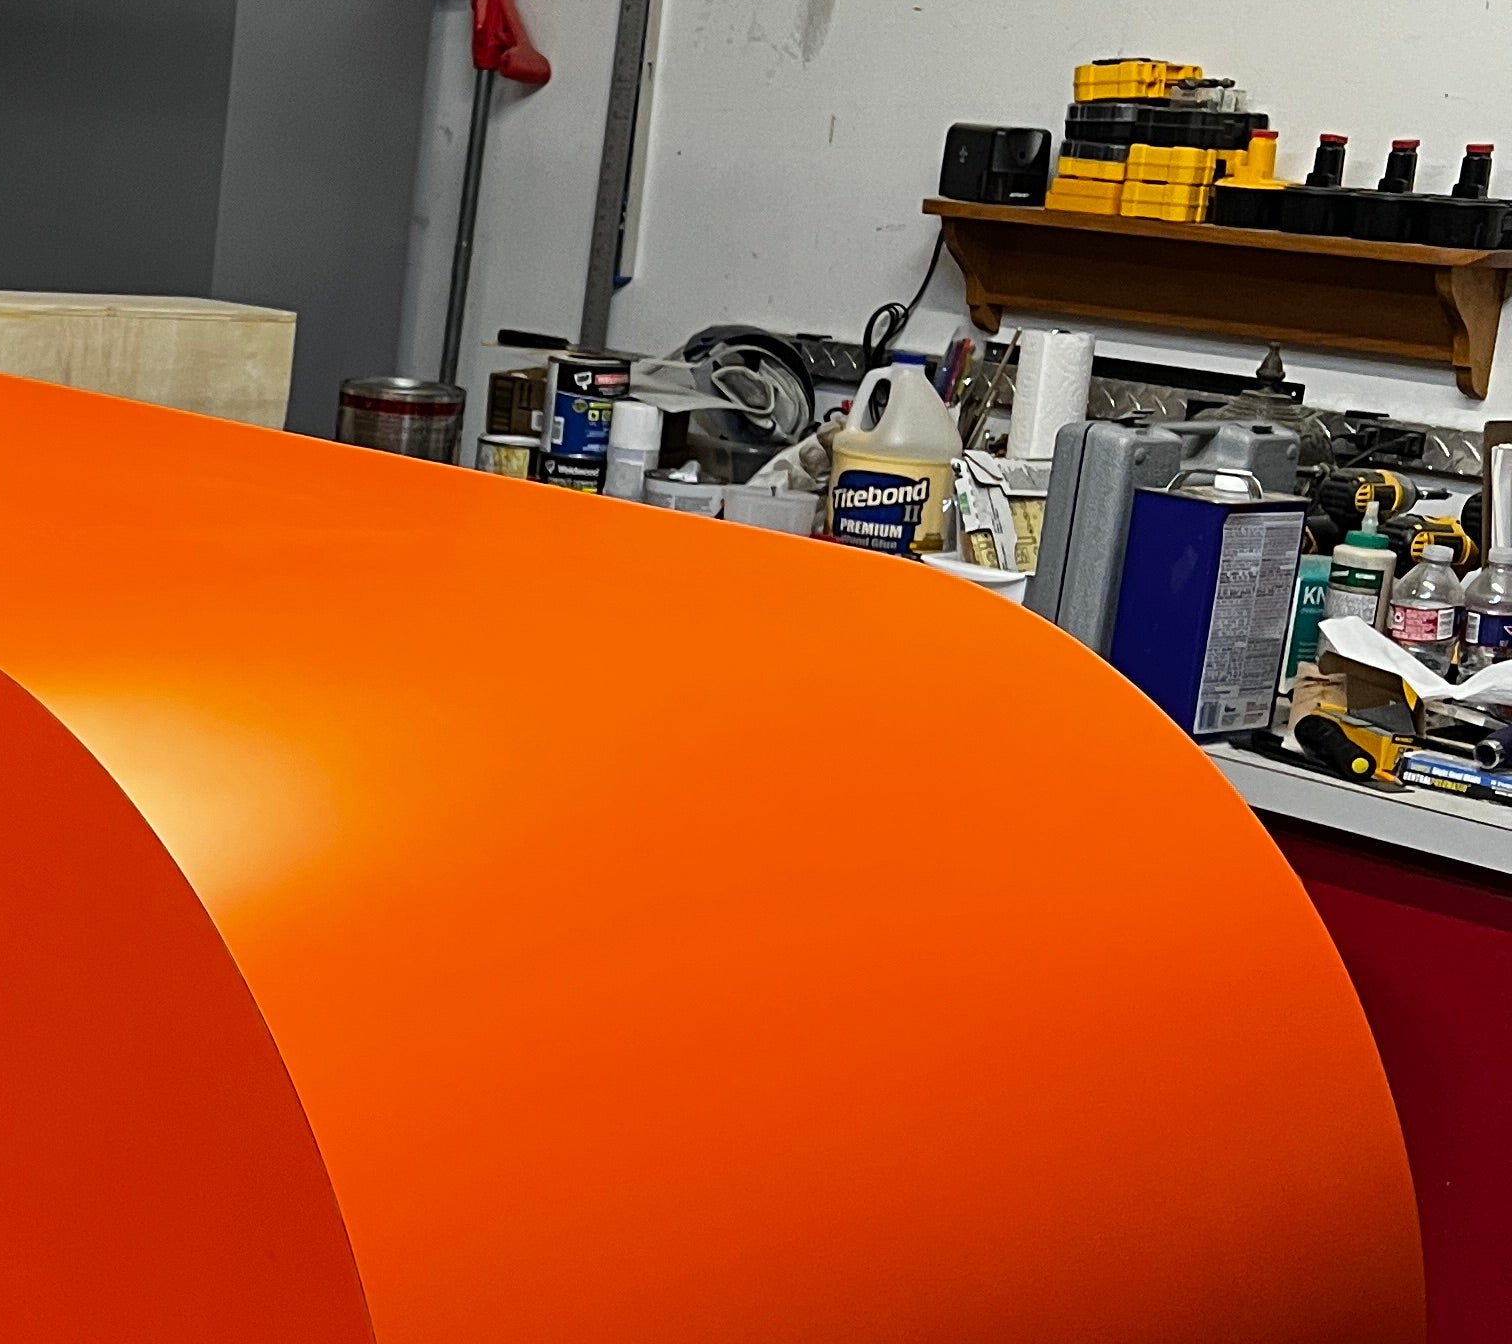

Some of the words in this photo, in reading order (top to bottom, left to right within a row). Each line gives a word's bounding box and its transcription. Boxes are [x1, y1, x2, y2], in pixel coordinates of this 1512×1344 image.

[834, 480, 928, 508] Titebond
[903, 504, 920, 523] II
[840, 518, 903, 539] PREMIUM
